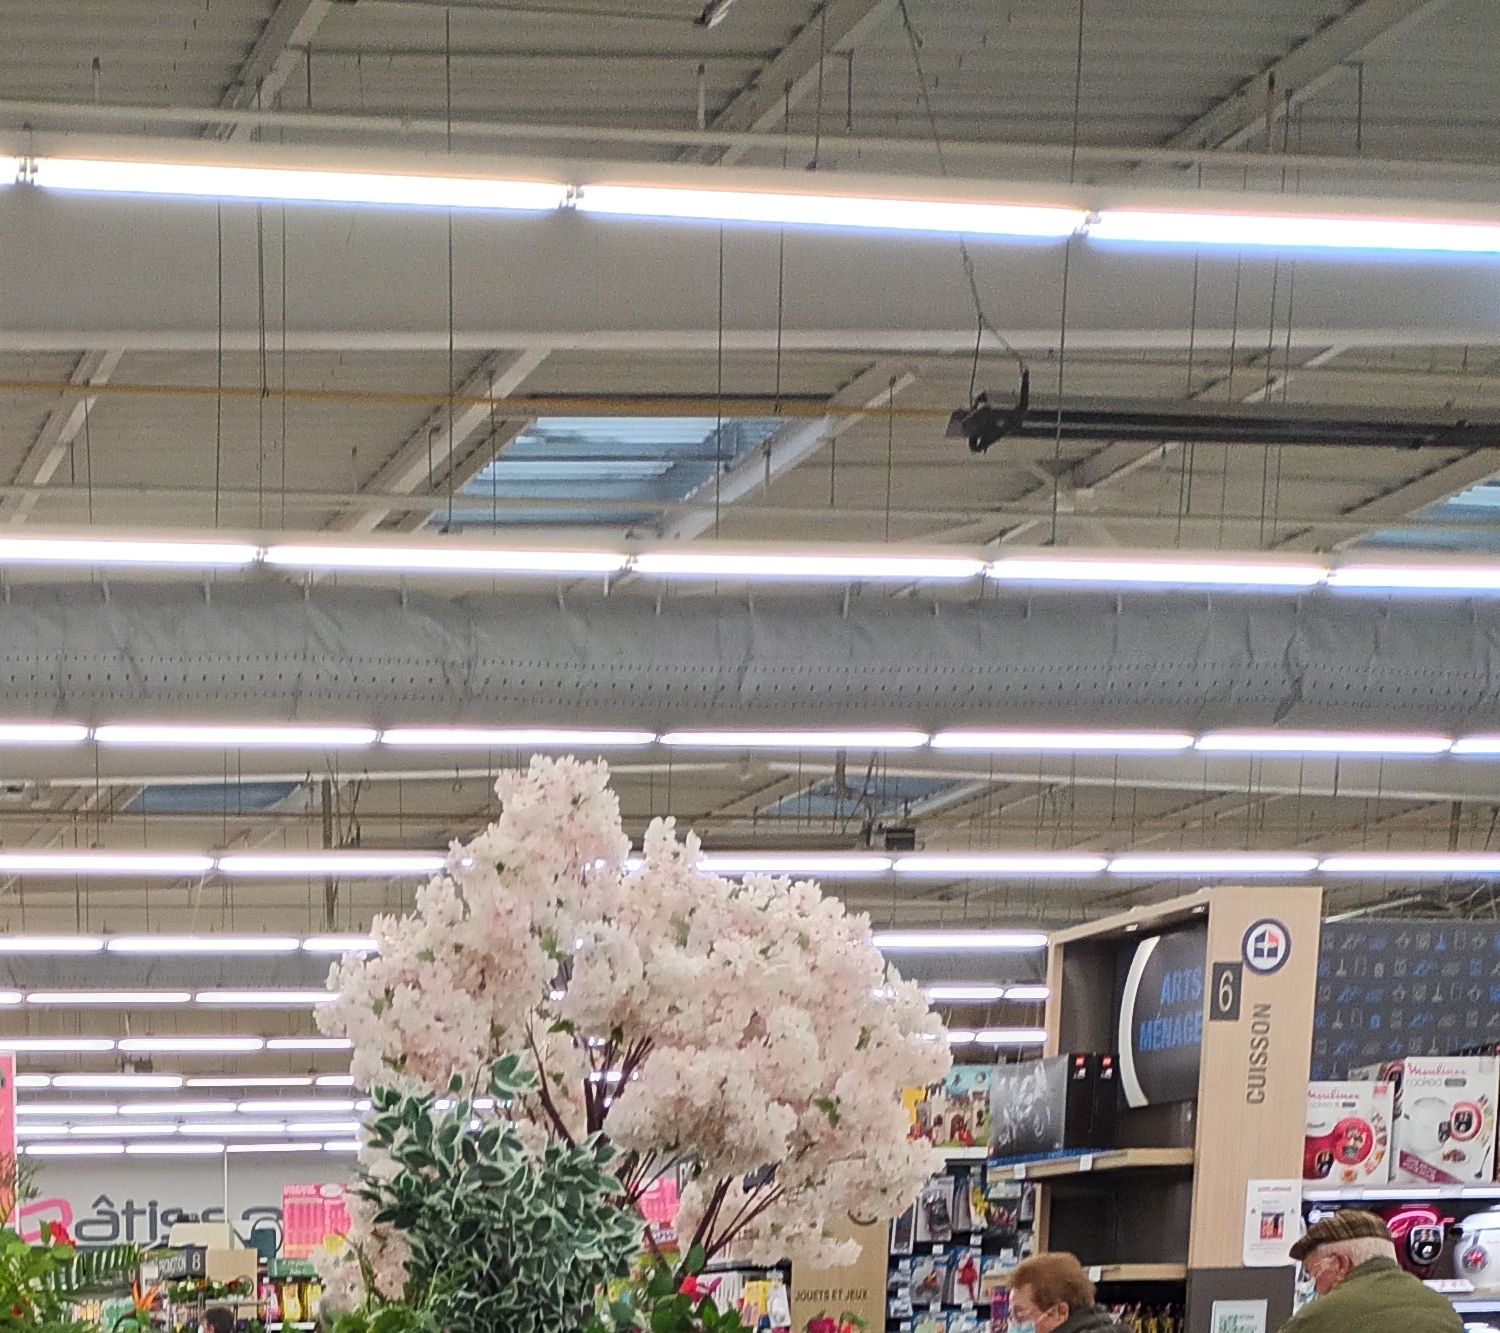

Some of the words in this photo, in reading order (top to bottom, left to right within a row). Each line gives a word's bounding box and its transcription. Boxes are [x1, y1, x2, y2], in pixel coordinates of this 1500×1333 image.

[1160, 967, 1203, 1005] ARTS
[1218, 970, 1233, 1012] 6
[1247, 1003, 1272, 1105] CUISSON
